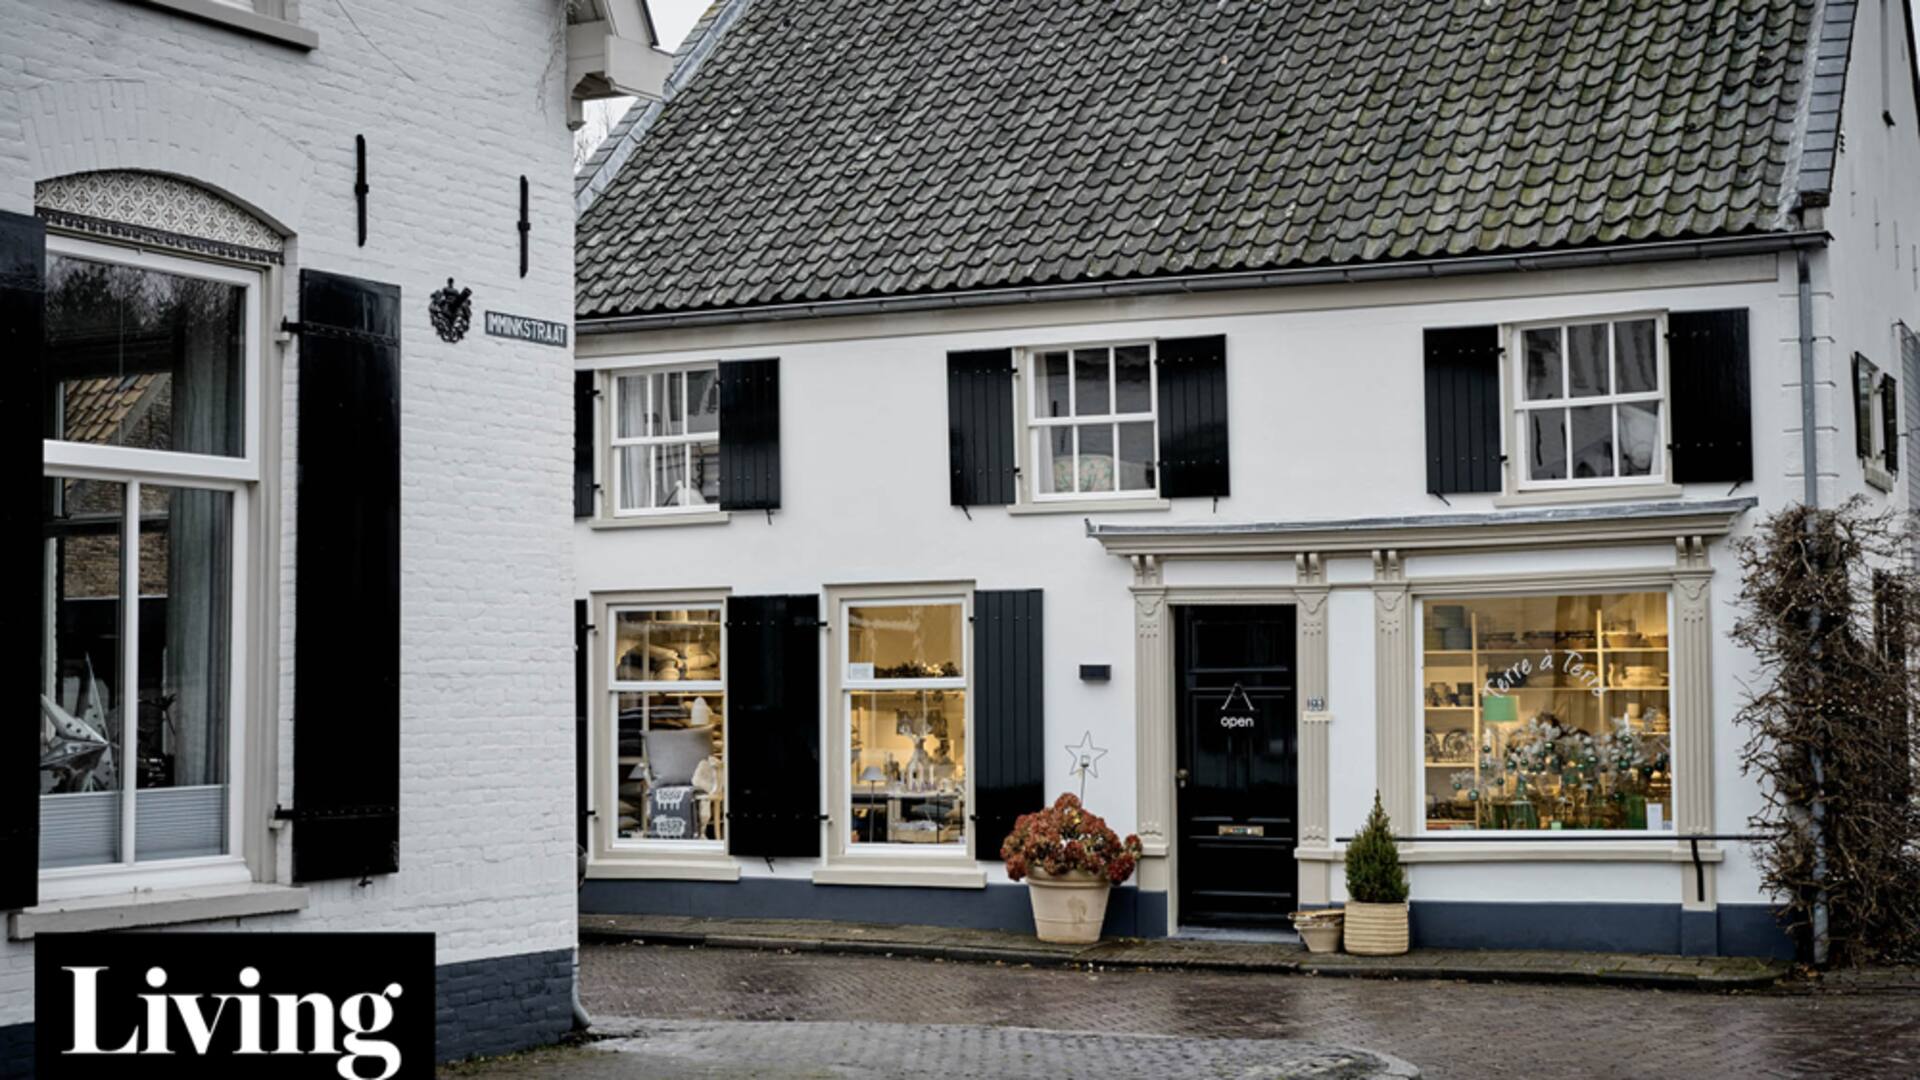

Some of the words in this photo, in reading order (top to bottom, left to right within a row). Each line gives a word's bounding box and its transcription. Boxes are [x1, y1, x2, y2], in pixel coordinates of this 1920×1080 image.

[1481, 658, 1533, 699] Terre
[1539, 648, 1555, 671] à
[1562, 649, 1609, 697] Terre
[1220, 716, 1255, 729] open
